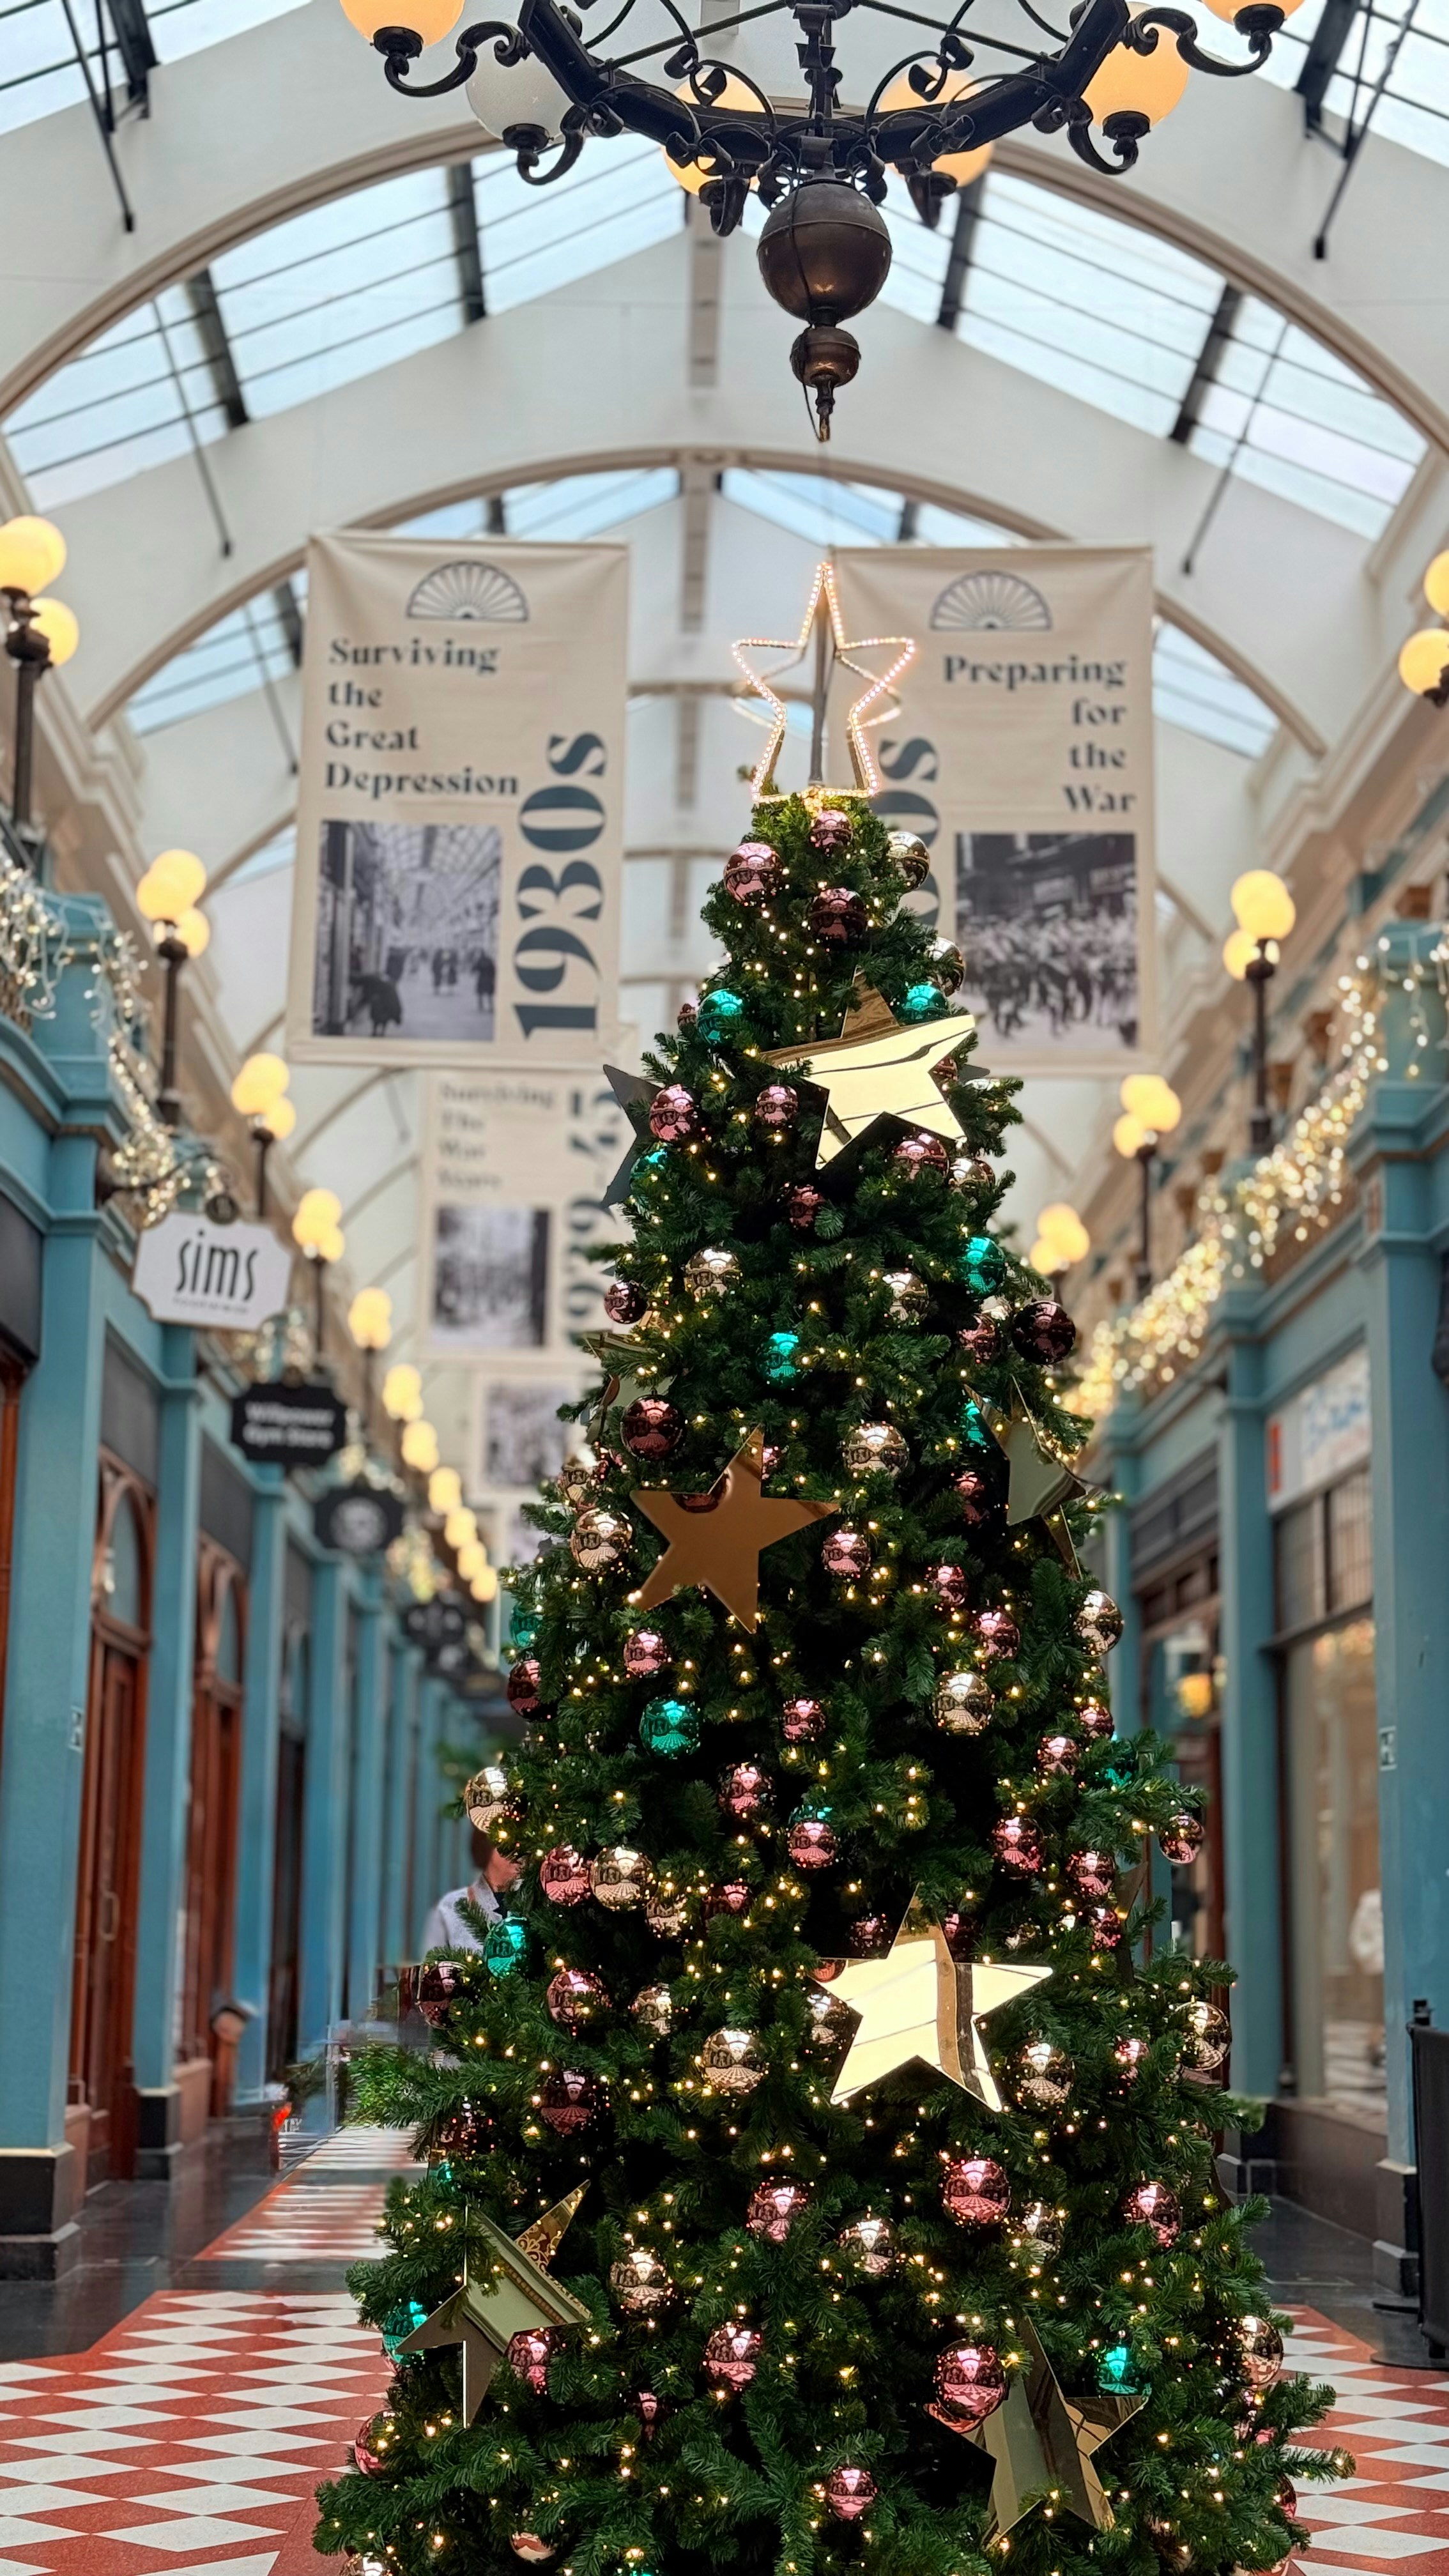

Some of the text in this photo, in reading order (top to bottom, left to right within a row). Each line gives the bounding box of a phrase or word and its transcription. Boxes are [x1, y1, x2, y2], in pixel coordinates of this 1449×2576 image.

[328, 638, 499, 674] Surviving
[944, 656, 1126, 690] Preparing
[328, 680, 383, 707] the
[1071, 698, 1126, 726] for
[325, 722, 419, 750] Great
[1069, 742, 1126, 769] the
[325, 763, 519, 799] Depression
[1063, 786, 1136, 813] War
[512, 733, 606, 1041] 1930s
[176, 1229, 259, 1301] sims
